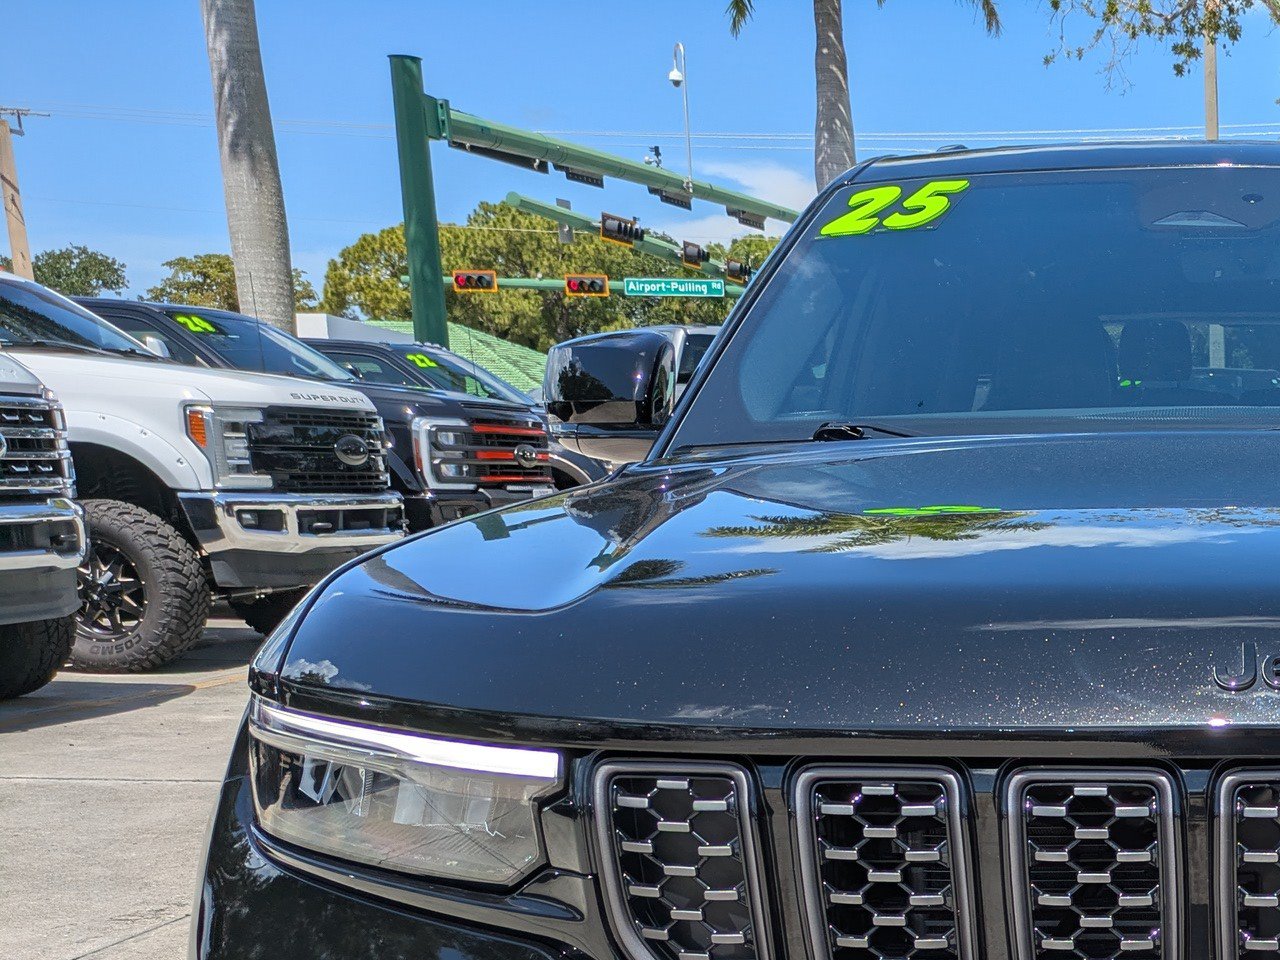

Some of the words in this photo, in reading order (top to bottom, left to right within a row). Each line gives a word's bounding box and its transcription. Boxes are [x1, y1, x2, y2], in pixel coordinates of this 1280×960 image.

[820, 180, 969, 236] 25
[628, 282, 708, 294] Airport-Pulling
[711, 282, 721, 290] Rd
[176, 316, 216, 332] 24
[406, 354, 438, 368] 22
[290, 393, 339, 402] SUPER
[89, 633, 142, 656] COSMO
